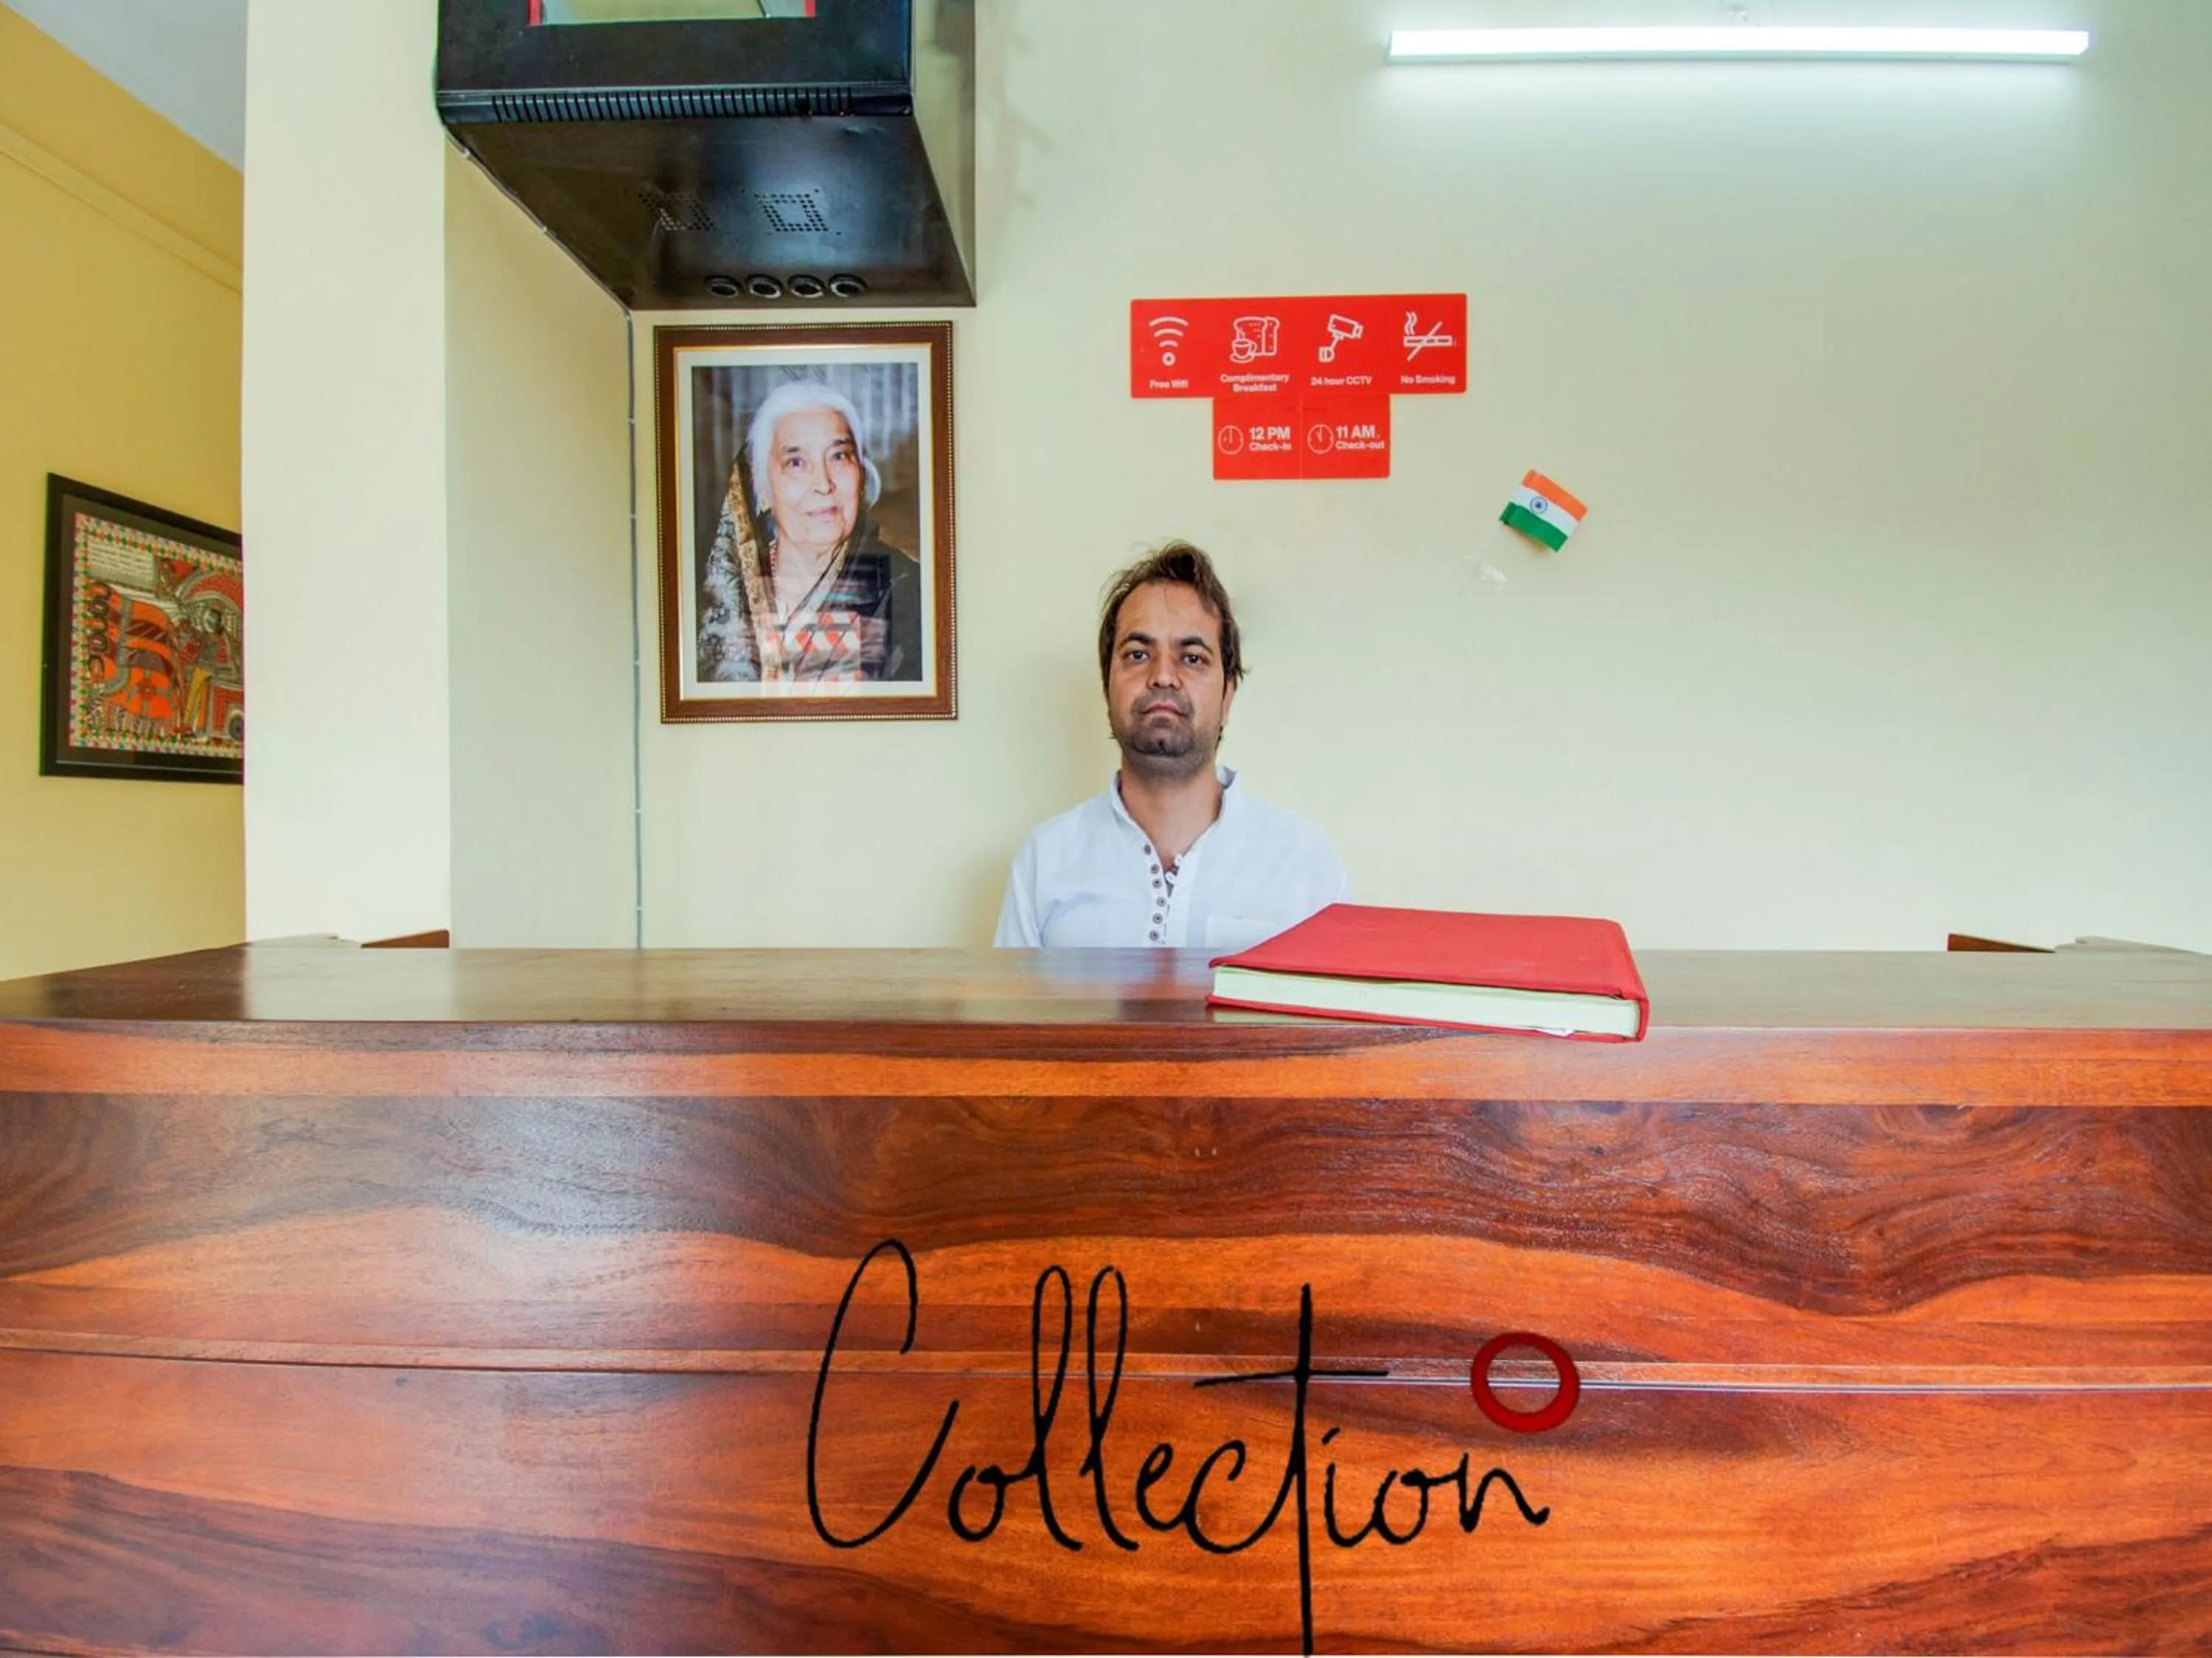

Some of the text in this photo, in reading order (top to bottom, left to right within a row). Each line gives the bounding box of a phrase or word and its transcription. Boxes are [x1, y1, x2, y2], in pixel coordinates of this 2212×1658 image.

[1220, 373, 1289, 384] Complimentary
[1310, 375, 1373, 386] 24 hour CCTV
[1400, 375, 1455, 385] No Smoking
[1149, 380, 1170, 389] Free
[1232, 383, 1277, 392] Breakfast
[1249, 426, 1290, 440] 12 PM
[1335, 425, 1375, 439] 11 AM
[1248, 442, 1292, 451] Check-in
[1335, 440, 1385, 450] Check-out
[807, 1239, 1550, 1655] Collection
